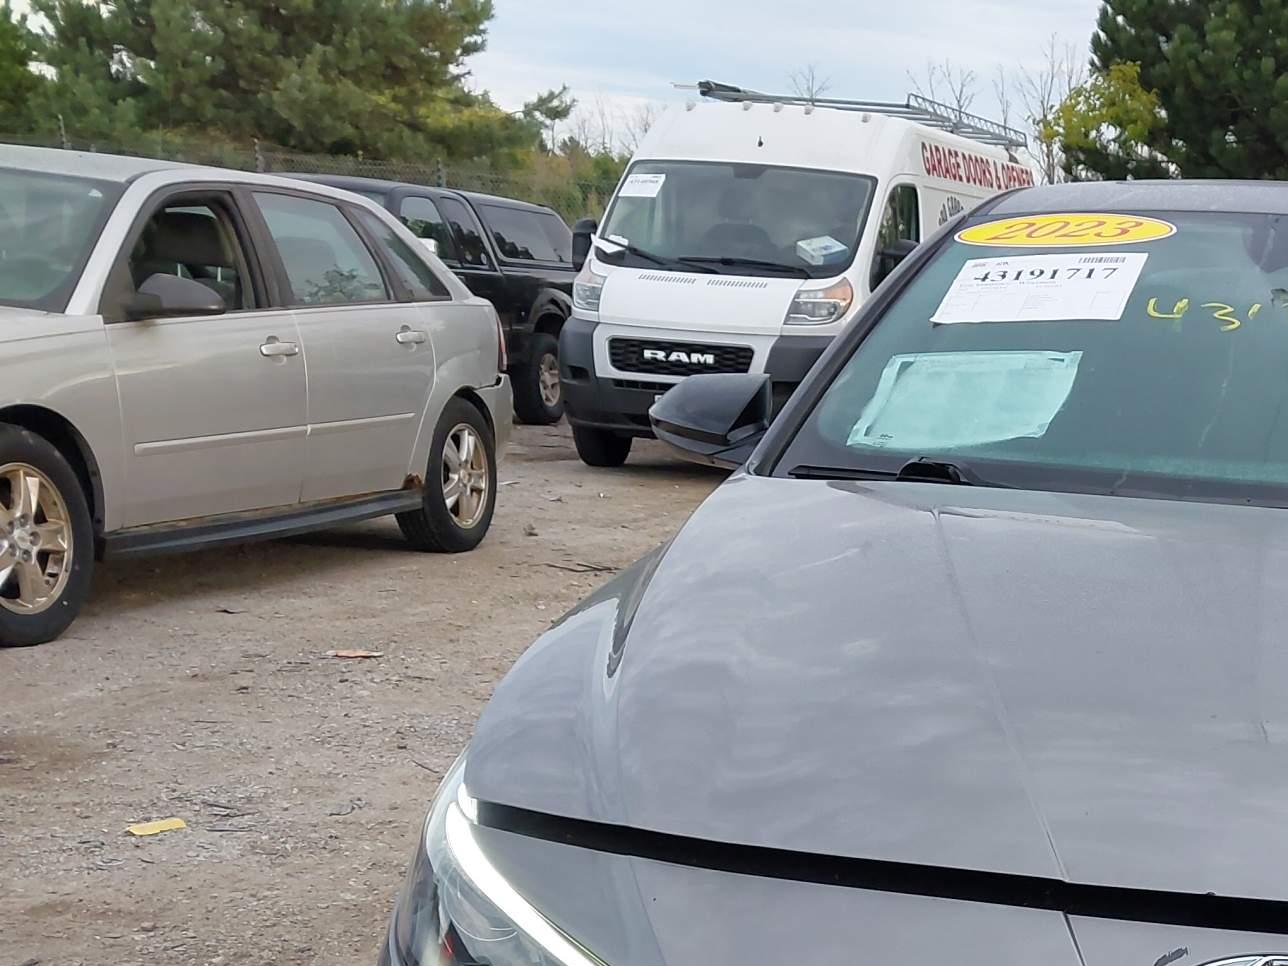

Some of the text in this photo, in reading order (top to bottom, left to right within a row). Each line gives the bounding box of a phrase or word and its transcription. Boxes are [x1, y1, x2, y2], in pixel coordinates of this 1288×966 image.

[921, 142, 963, 182] GARAGE
[962, 151, 993, 189] DOORS
[985, 220, 1144, 241] 2023
[973, 266, 1119, 283] 43191717
[643, 348, 715, 365] RAM
